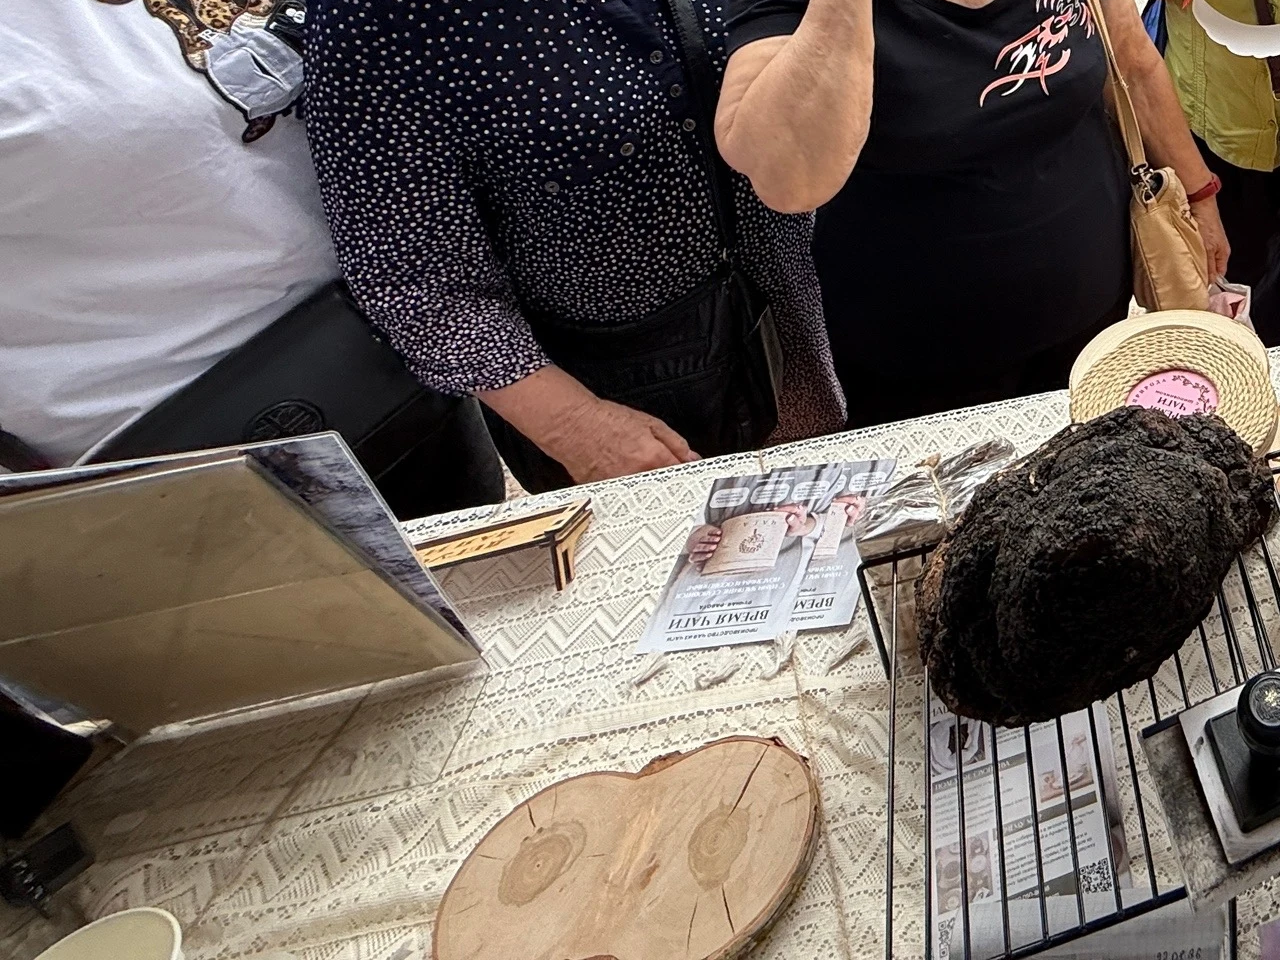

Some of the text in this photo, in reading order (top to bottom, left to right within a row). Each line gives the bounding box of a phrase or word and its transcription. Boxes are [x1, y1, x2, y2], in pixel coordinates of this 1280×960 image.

[1157, 397, 1186, 411] ЧАГИ
[793, 597, 835, 610] ВРЕМ
[668, 610, 770, 630] ВРЕМЯ ЧАГИ
[707, 628, 759, 638] ПРОИЗВОДСТВО
